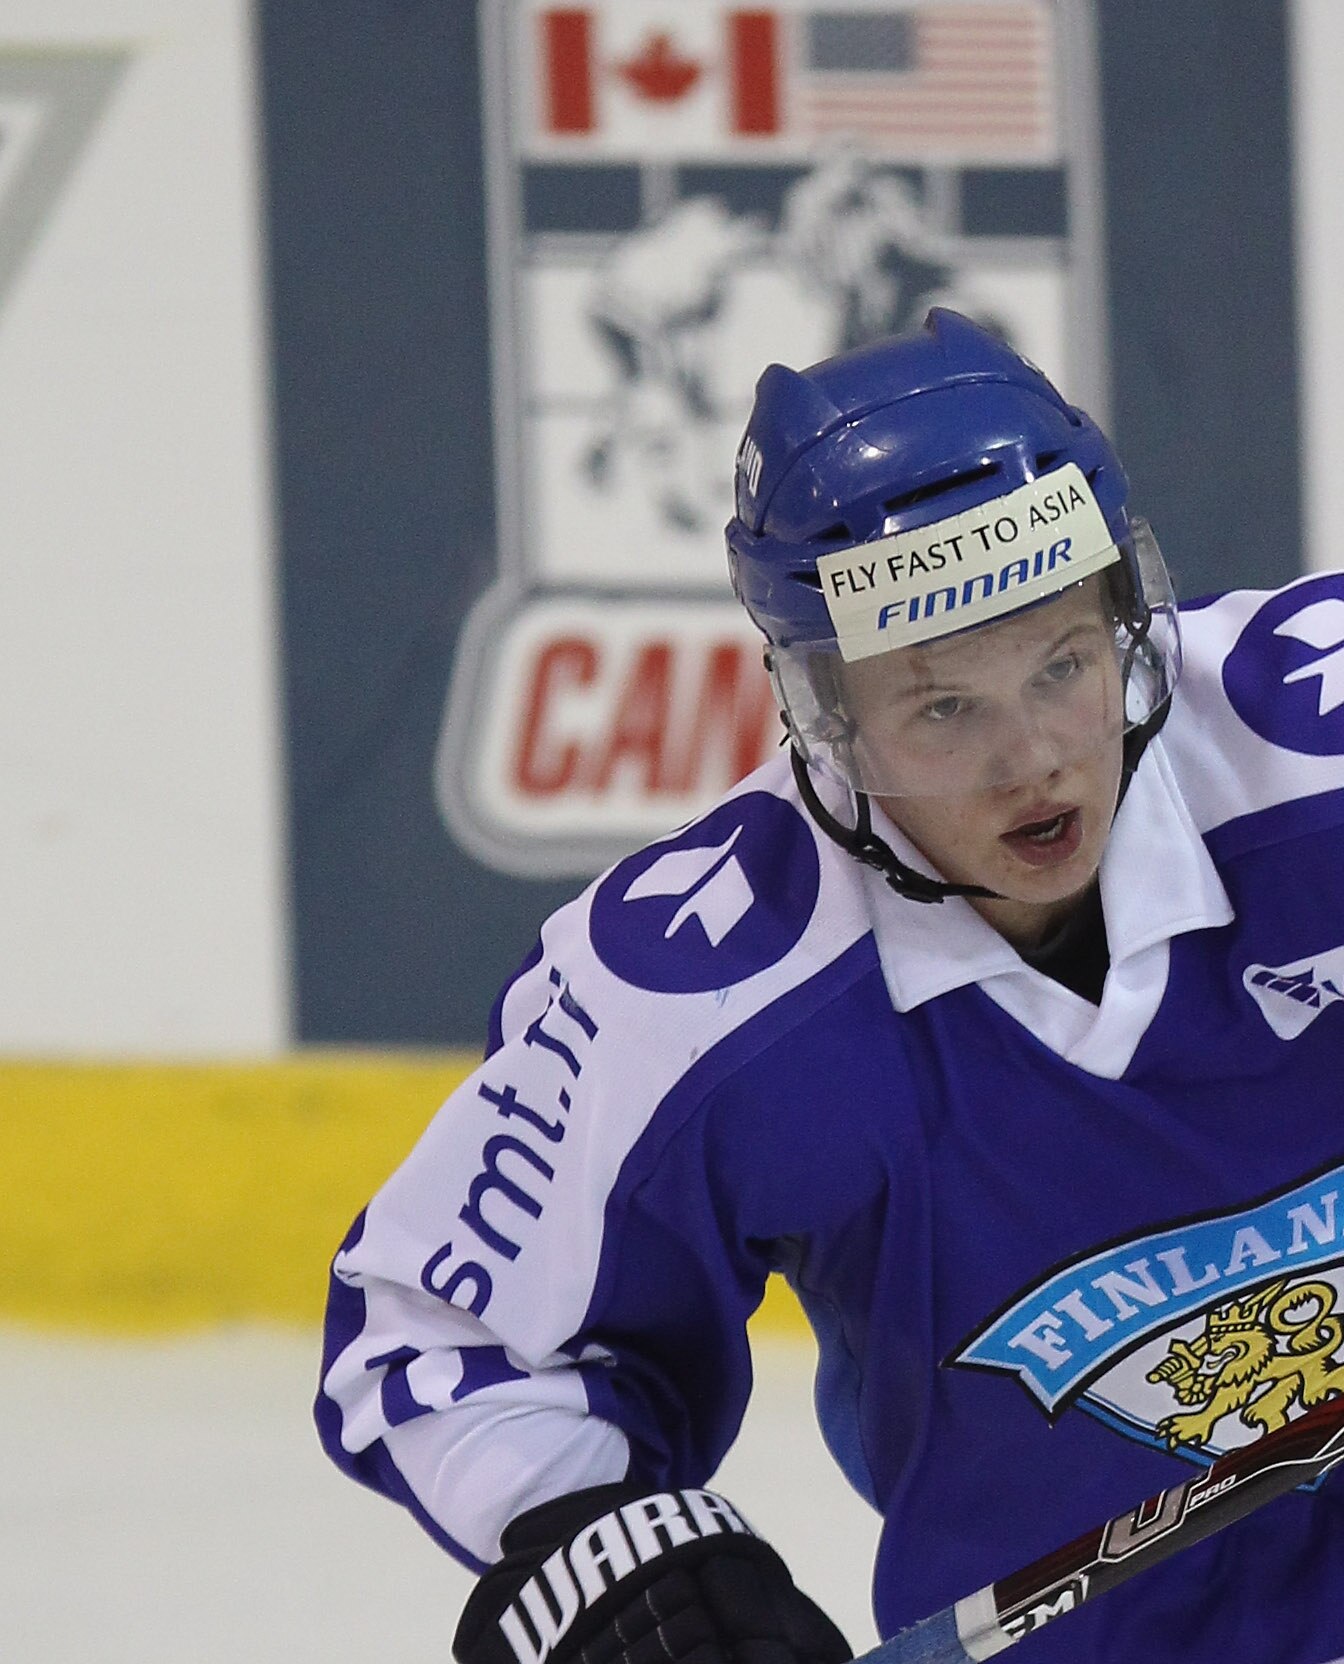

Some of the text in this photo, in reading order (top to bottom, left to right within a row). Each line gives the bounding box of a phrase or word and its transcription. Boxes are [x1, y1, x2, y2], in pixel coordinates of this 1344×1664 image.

[829, 484, 1087, 598] FLY FAST TO ASIA
[876, 536, 1074, 630] FINNAIR
[1189, 1474, 1237, 1508] PRO
